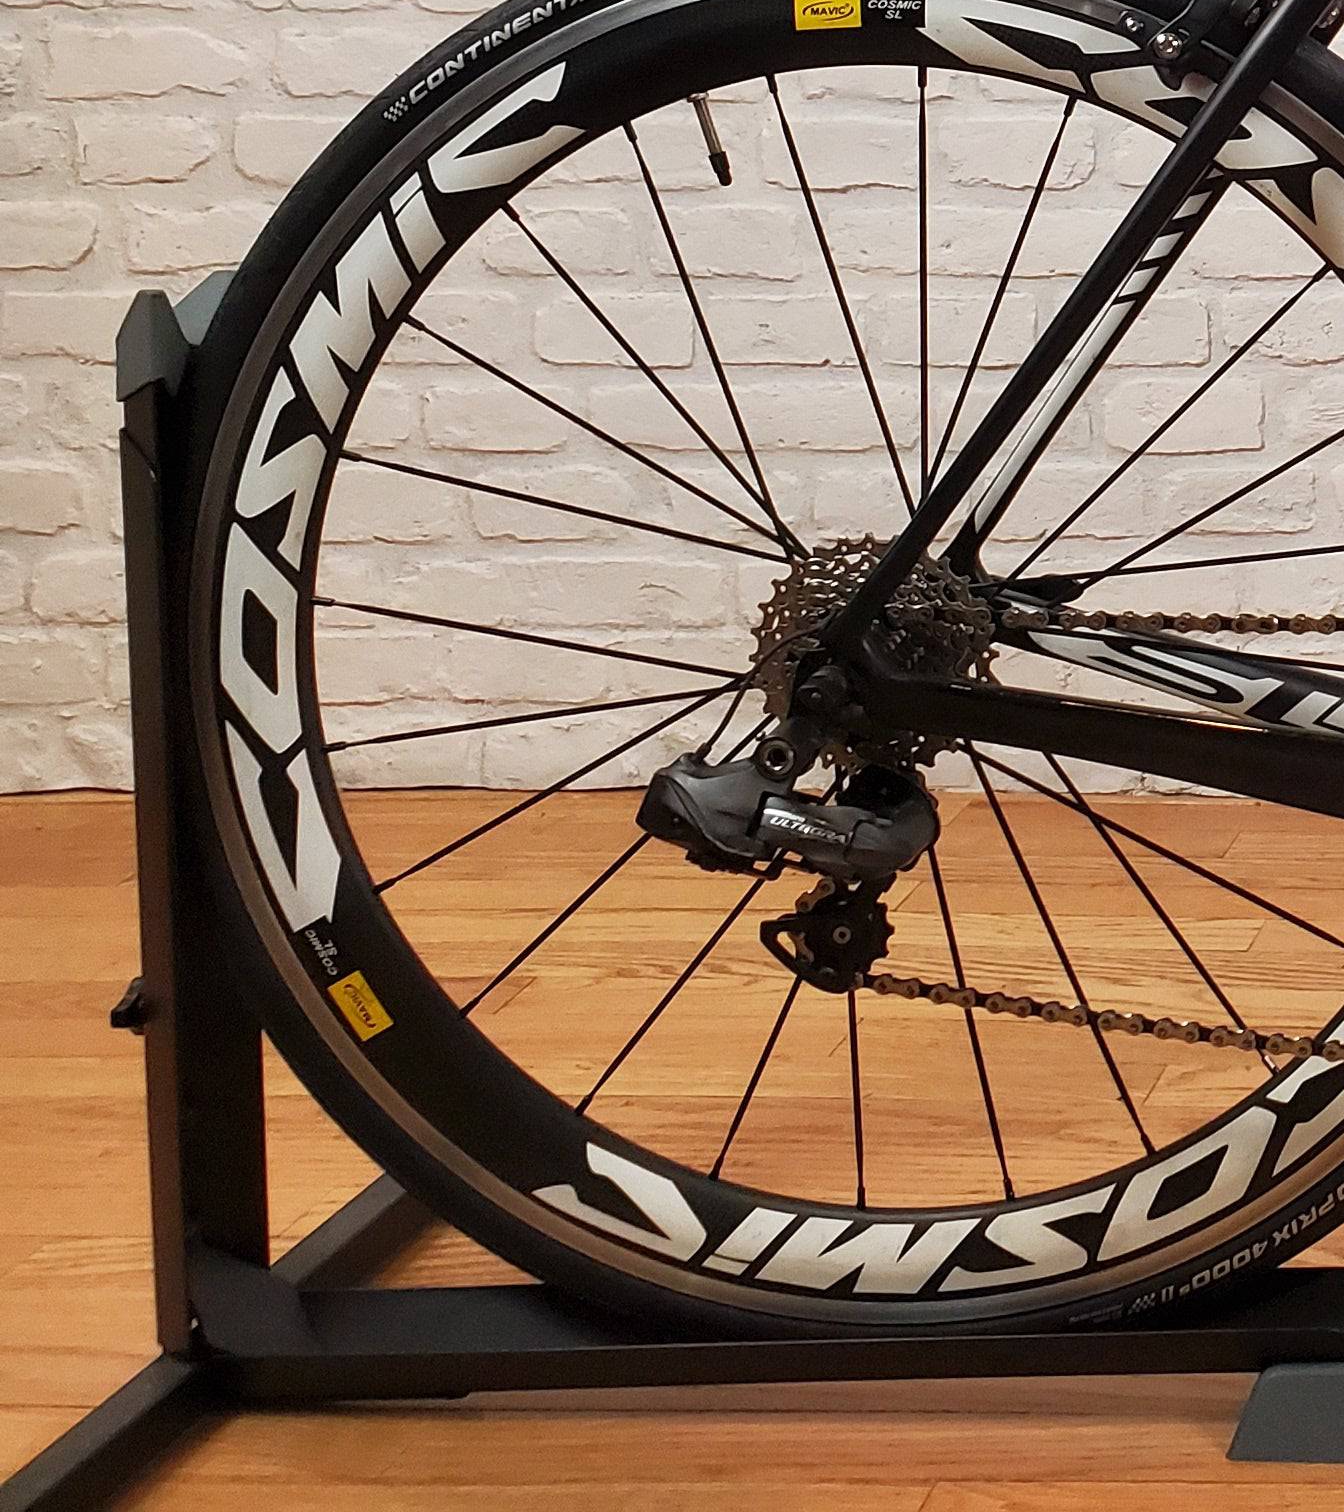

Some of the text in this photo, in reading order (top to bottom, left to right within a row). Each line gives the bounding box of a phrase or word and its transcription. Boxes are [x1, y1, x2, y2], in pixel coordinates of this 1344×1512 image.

[867, 0, 922, 10] COSMIC
[884, 9, 902, 19] SL
[305, 929, 338, 976] COSMIC
[1272, 1192, 1336, 1247] PRIX
